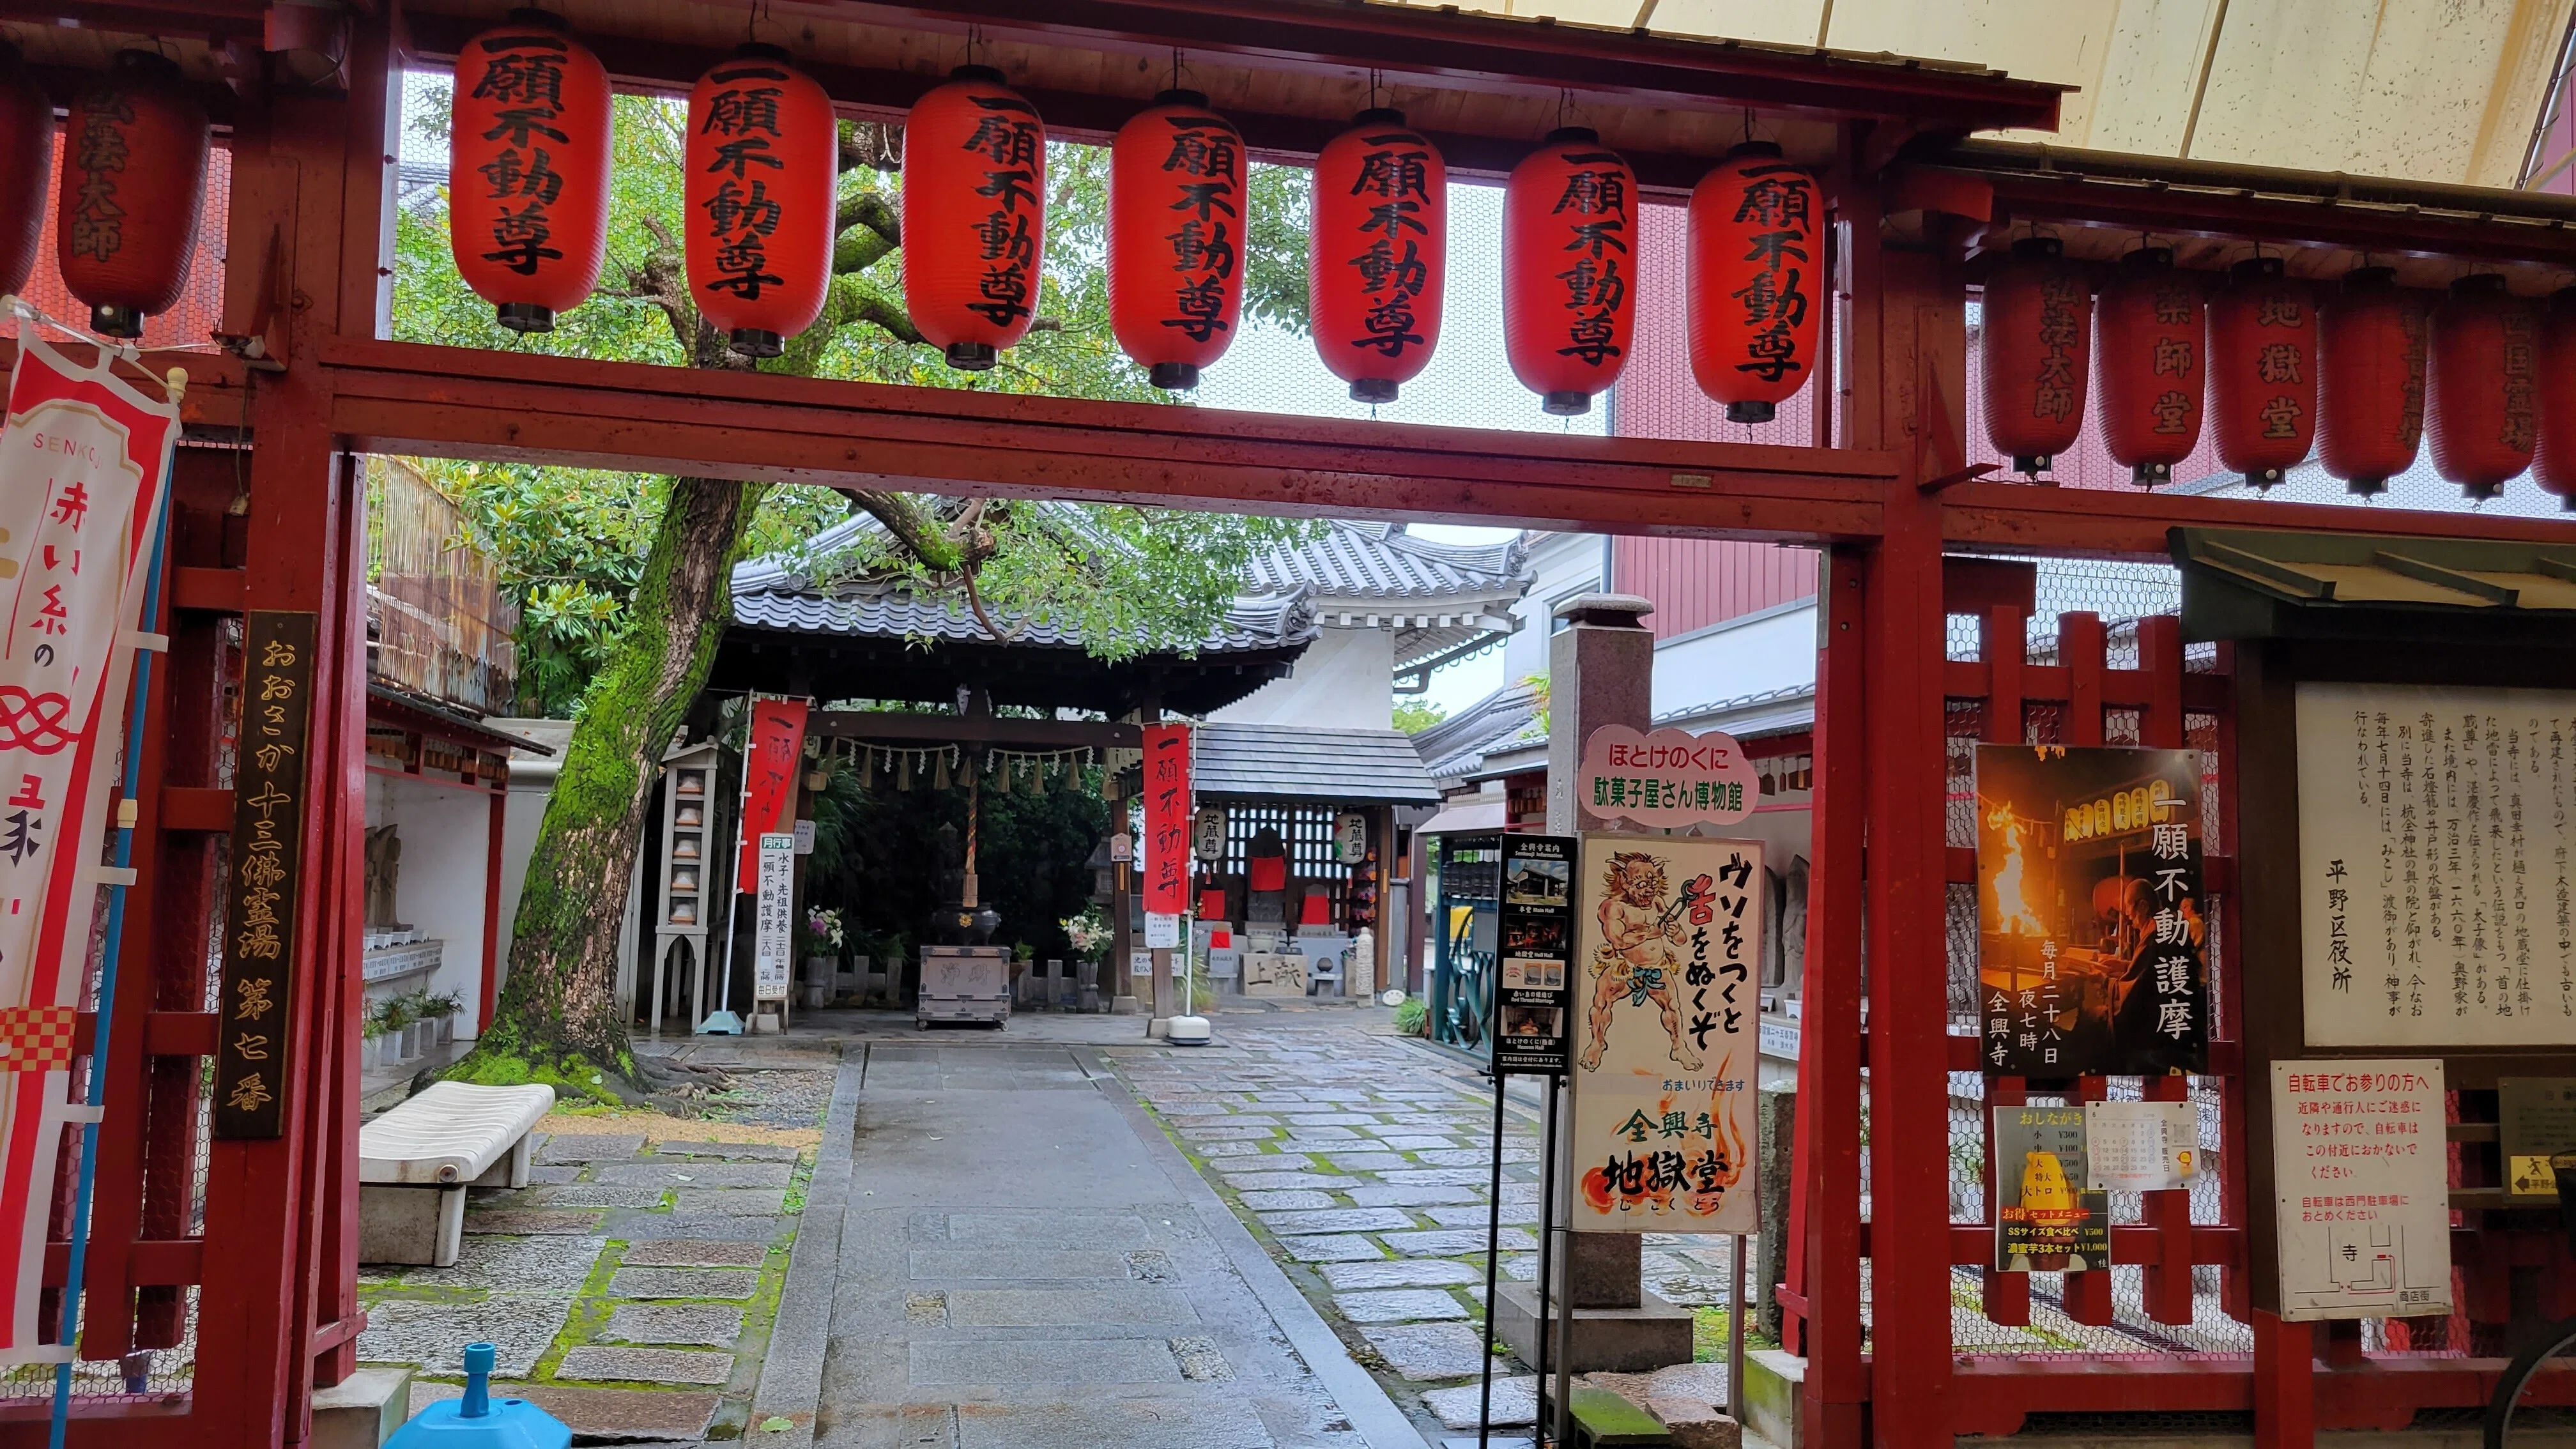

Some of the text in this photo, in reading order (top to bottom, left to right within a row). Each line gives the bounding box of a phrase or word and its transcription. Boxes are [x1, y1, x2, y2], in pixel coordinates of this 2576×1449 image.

[471, 36, 570, 276] 一願不動尊
[703, 67, 784, 300] 一願不動尊
[962, 96, 1039, 328] 一願不動尊
[1162, 116, 1238, 342] 一願不動尊
[1348, 133, 1430, 358] 一願不動尊
[1551, 152, 1627, 366] 一願不動尊
[1732, 165, 1810, 381] 一願不動尊
[2258, 295, 2303, 439] 地獄堂
[1609, 743, 1729, 770] ほとけのくに
[2354, 710, 2372, 808] 行なわれている。
[1593, 776, 1744, 812] 駄菓子屋さん博物館
[1156, 738, 1181, 899] 一願不動尊
[1204, 814, 1219, 854] 地蔵尊
[1349, 818, 1363, 857] 地蔵尊
[2151, 798, 2194, 1040] 一願不動護摩
[2326, 859, 2353, 994] 平野区役所
[1719, 852, 1753, 1034] ウソをつくと
[1685, 873, 1721, 1051] 舌をぬくぞ
[758, 985, 785, 995] 毎日受付
[2040, 940, 2062, 1064] 毎月二十八日
[1987, 990, 2011, 1066] 全興寺
[2018, 990, 2038, 1052] 夜七時
[1662, 1076, 1745, 1092] おまいりできます
[2288, 1073, 2429, 1092] 自転車でお参りの方へ
[1616, 1108, 1718, 1142] 全興寺
[2020, 1112, 2082, 1126] おしながき
[2297, 1101, 2421, 1114] 近隣や通行人にご迷惑に
[2034, 1130, 2078, 1139] 小 ¥300
[2302, 1122, 2418, 1135] なりますので、自転車は
[2034, 1144, 2042, 1153] 中
[2035, 1159, 2078, 1168] 大 ¥500
[2306, 1143, 2418, 1157] この付近におかないで
[1602, 1149, 1729, 1195] 地獄堂
[2035, 1172, 2051, 1182] 特大
[2022, 1185, 2052, 1197] 大トロ
[2302, 1195, 2410, 1208] 自転車は西門駐車場に
[2007, 1227, 2104, 1237] SSサイズ食べ比べ ¥500
[2302, 1210, 2377, 1222] おとめください
[2342, 1244, 2358, 1262] 寺
[2399, 1291, 2430, 1302] 商店街
